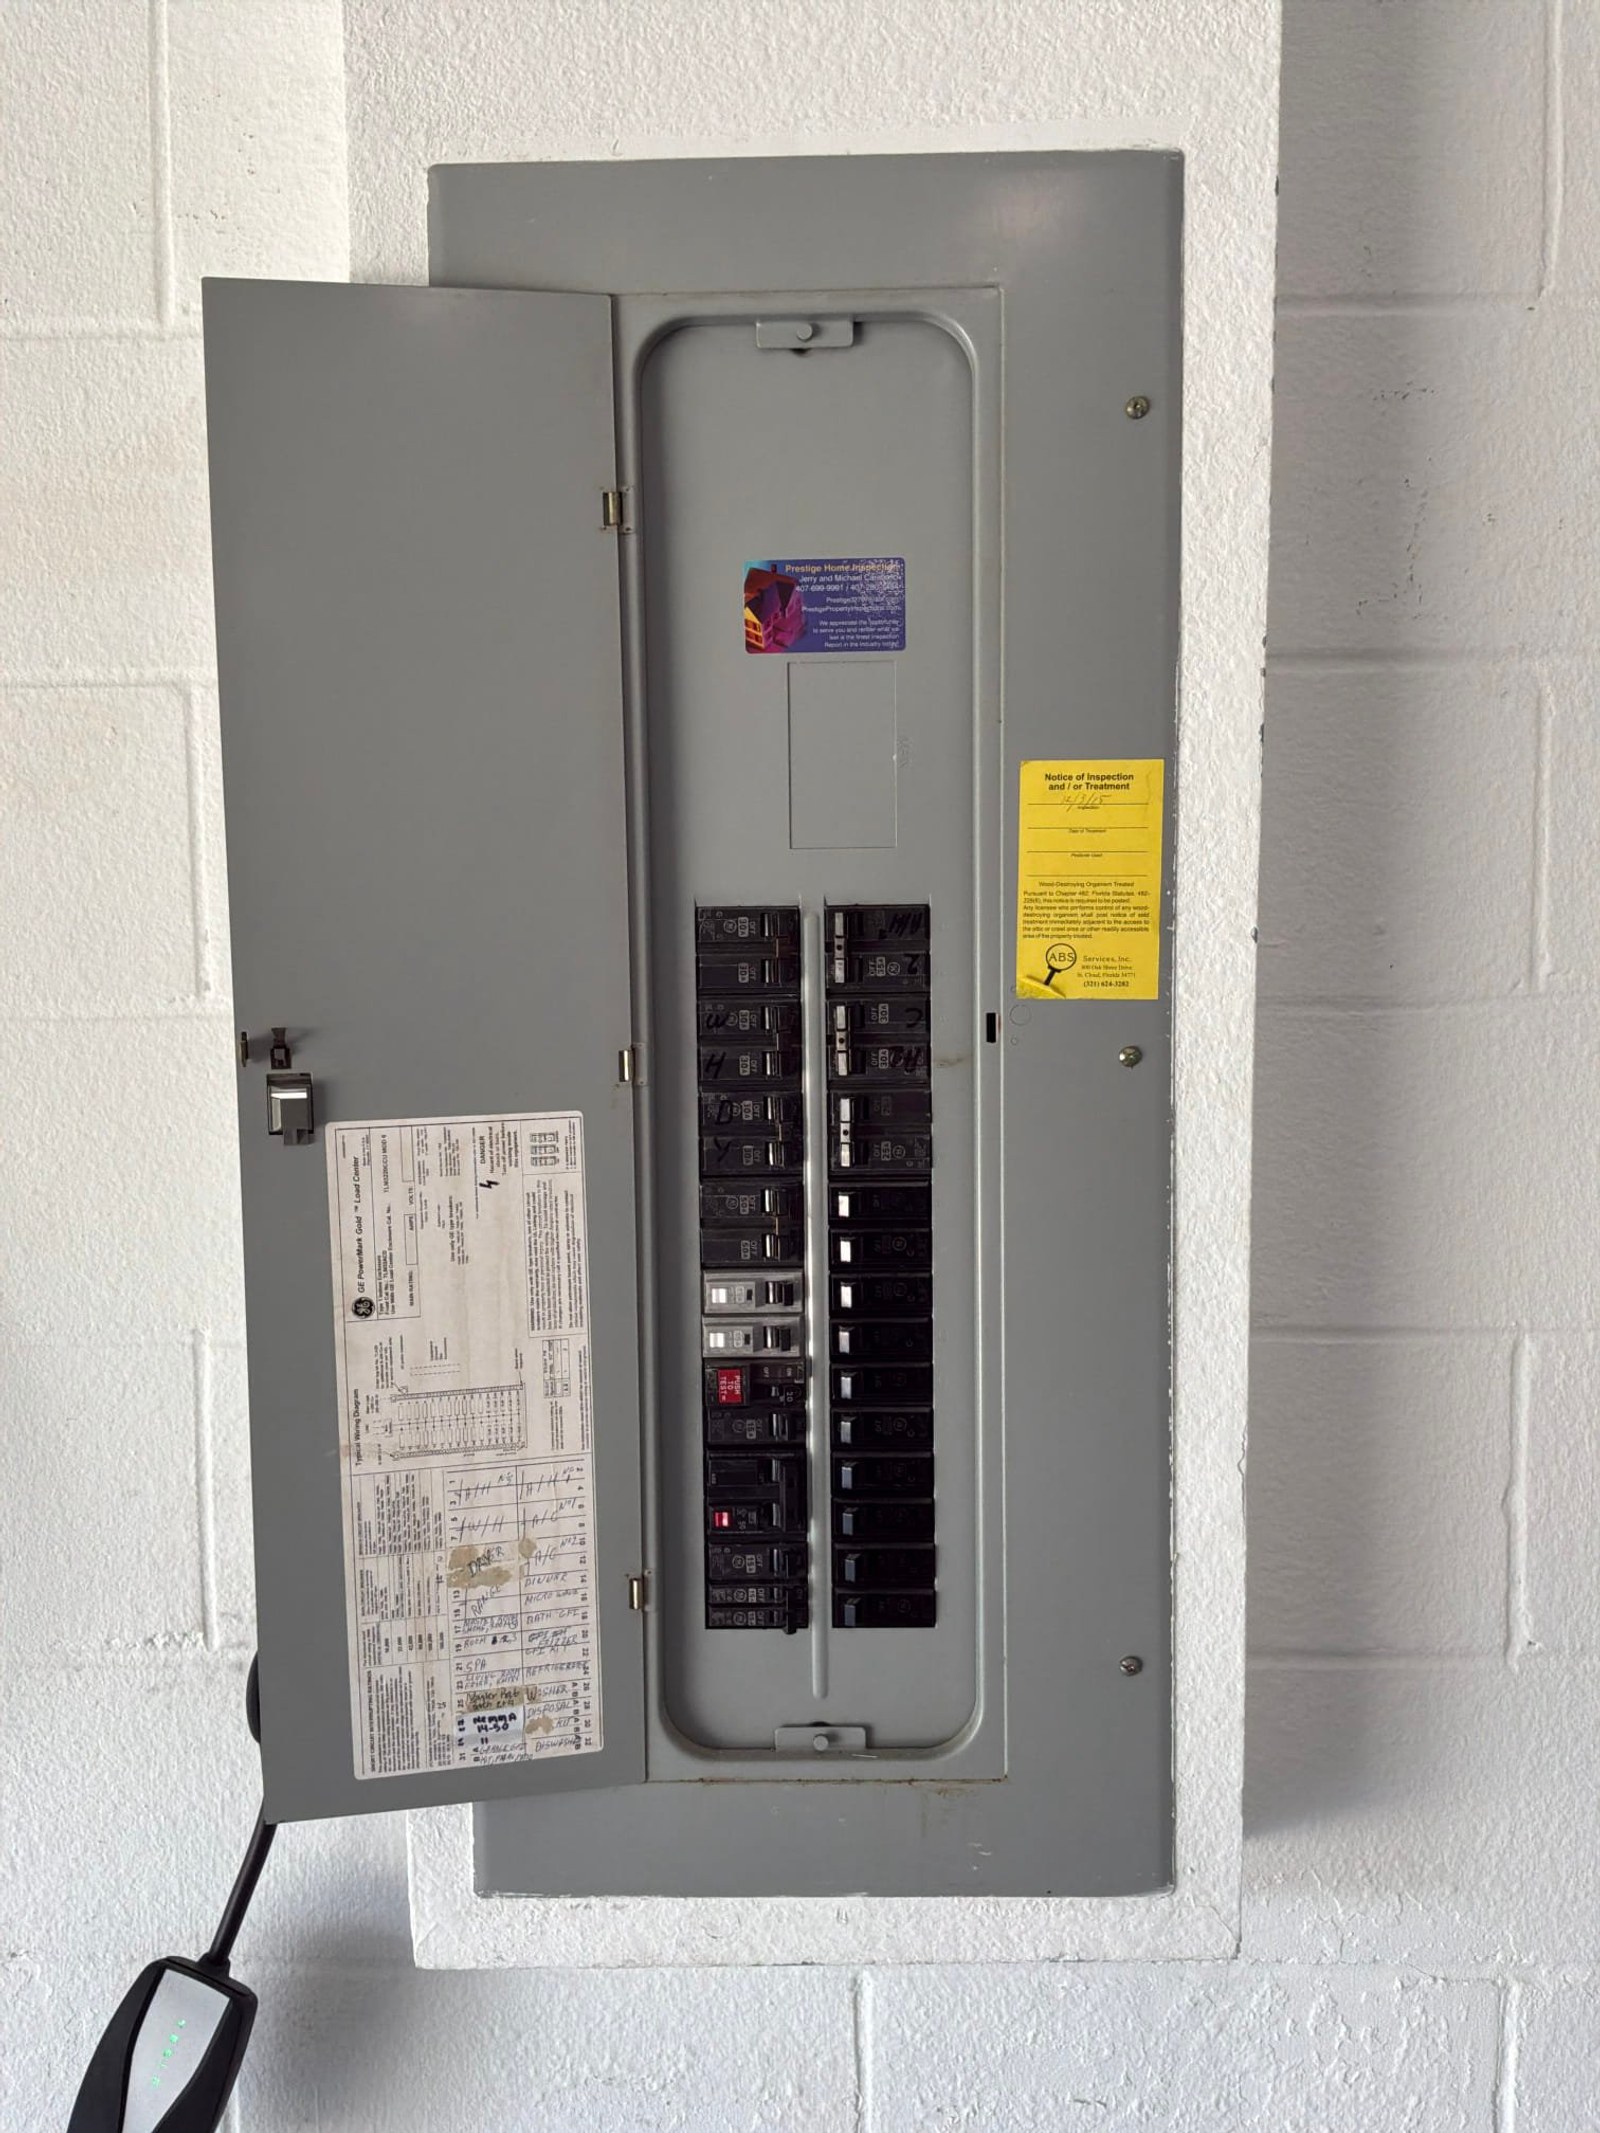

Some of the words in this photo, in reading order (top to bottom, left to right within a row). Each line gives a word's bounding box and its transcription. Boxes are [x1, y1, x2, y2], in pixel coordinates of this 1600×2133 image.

[785, 565, 822, 574] Prestige
[799, 575, 817, 583] Jerry
[1045, 773, 1073, 781] Notice
[1076, 773, 1085, 781] of
[1087, 773, 1134, 782] Inspection
[1085, 782, 1130, 791] Treatment
[1049, 953, 1075, 962] ABS
[879, 1004, 888, 1024] 30A
[879, 1049, 889, 1069] 30A
[705, 1052, 727, 1079] H
[741, 1056, 750, 1075] 30A
[352, 1156, 360, 1182] Center
[353, 1184, 361, 1203] Load
[355, 1216, 363, 1235] Gold
[356, 1238, 365, 1280] PowerMark
[357, 1281, 365, 1293] GE
[727, 1381, 734, 1390] TO
[355, 1442, 363, 1466] Typical
[579, 1556, 587, 1564] 12
[454, 1626, 461, 1634] 17
[455, 1644, 462, 1652] 19
[456, 1662, 463, 1671] 21
[466, 1659, 486, 1674] SPA
[456, 1681, 464, 1689] 23
[457, 1699, 464, 1708] 25
[477, 1723, 509, 1733] 14-50
